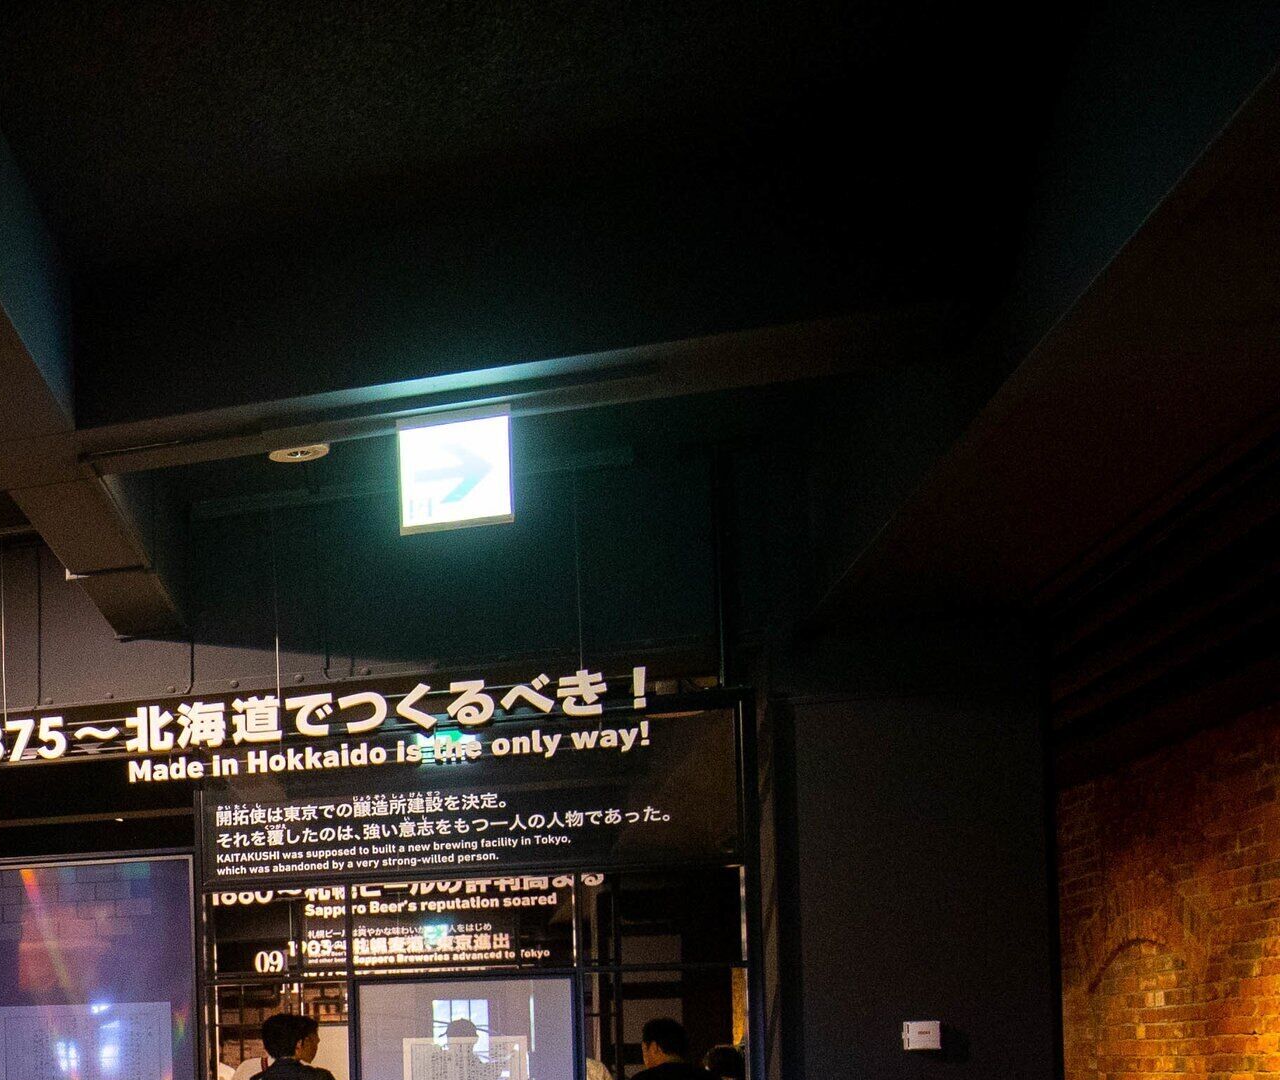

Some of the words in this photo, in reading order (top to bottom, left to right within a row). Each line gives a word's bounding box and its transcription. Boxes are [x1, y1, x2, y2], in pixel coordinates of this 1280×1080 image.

[129, 757, 204, 782] Made
[212, 755, 239, 776] in
[247, 743, 386, 774] Hokkaido
[397, 739, 423, 762] is
[433, 733, 481, 761] the
[492, 730, 562, 758] only
[572, 720, 650, 750] way!
[216, 793, 507, 827] 開拓使は東京での醸造所建設を決定。
[216, 806, 671, 849] それを覆したのは、強い意志をもつ一人の人物であった。
[216, 851, 280, 863] KAITAKUSHI
[282, 851, 304, 860] was
[306, 847, 357, 861] supposed
[358, 846, 369, 856] to
[371, 844, 396, 855] built
[398, 845, 405, 853] a
[407, 844, 431, 853] new
[434, 841, 478, 851] brewing
[481, 836, 518, 848] facility
[521, 836, 531, 846] in
[534, 834, 571, 847] Tokyo,
[216, 865, 247, 876] which
[249, 865, 270, 874] was
[272, 861, 329, 873] abandoned
[332, 860, 345, 872] by
[356, 859, 380, 870] very
[382, 854, 455, 868] strong-willed
[457, 852, 499, 864] person.
[369, 899, 417, 914] Beer's
[421, 896, 499, 912] reputation
[503, 892, 557, 907] soared
[255, 951, 284, 973] 09
[452, 950, 502, 961] advanced
[504, 950, 516, 959] to
